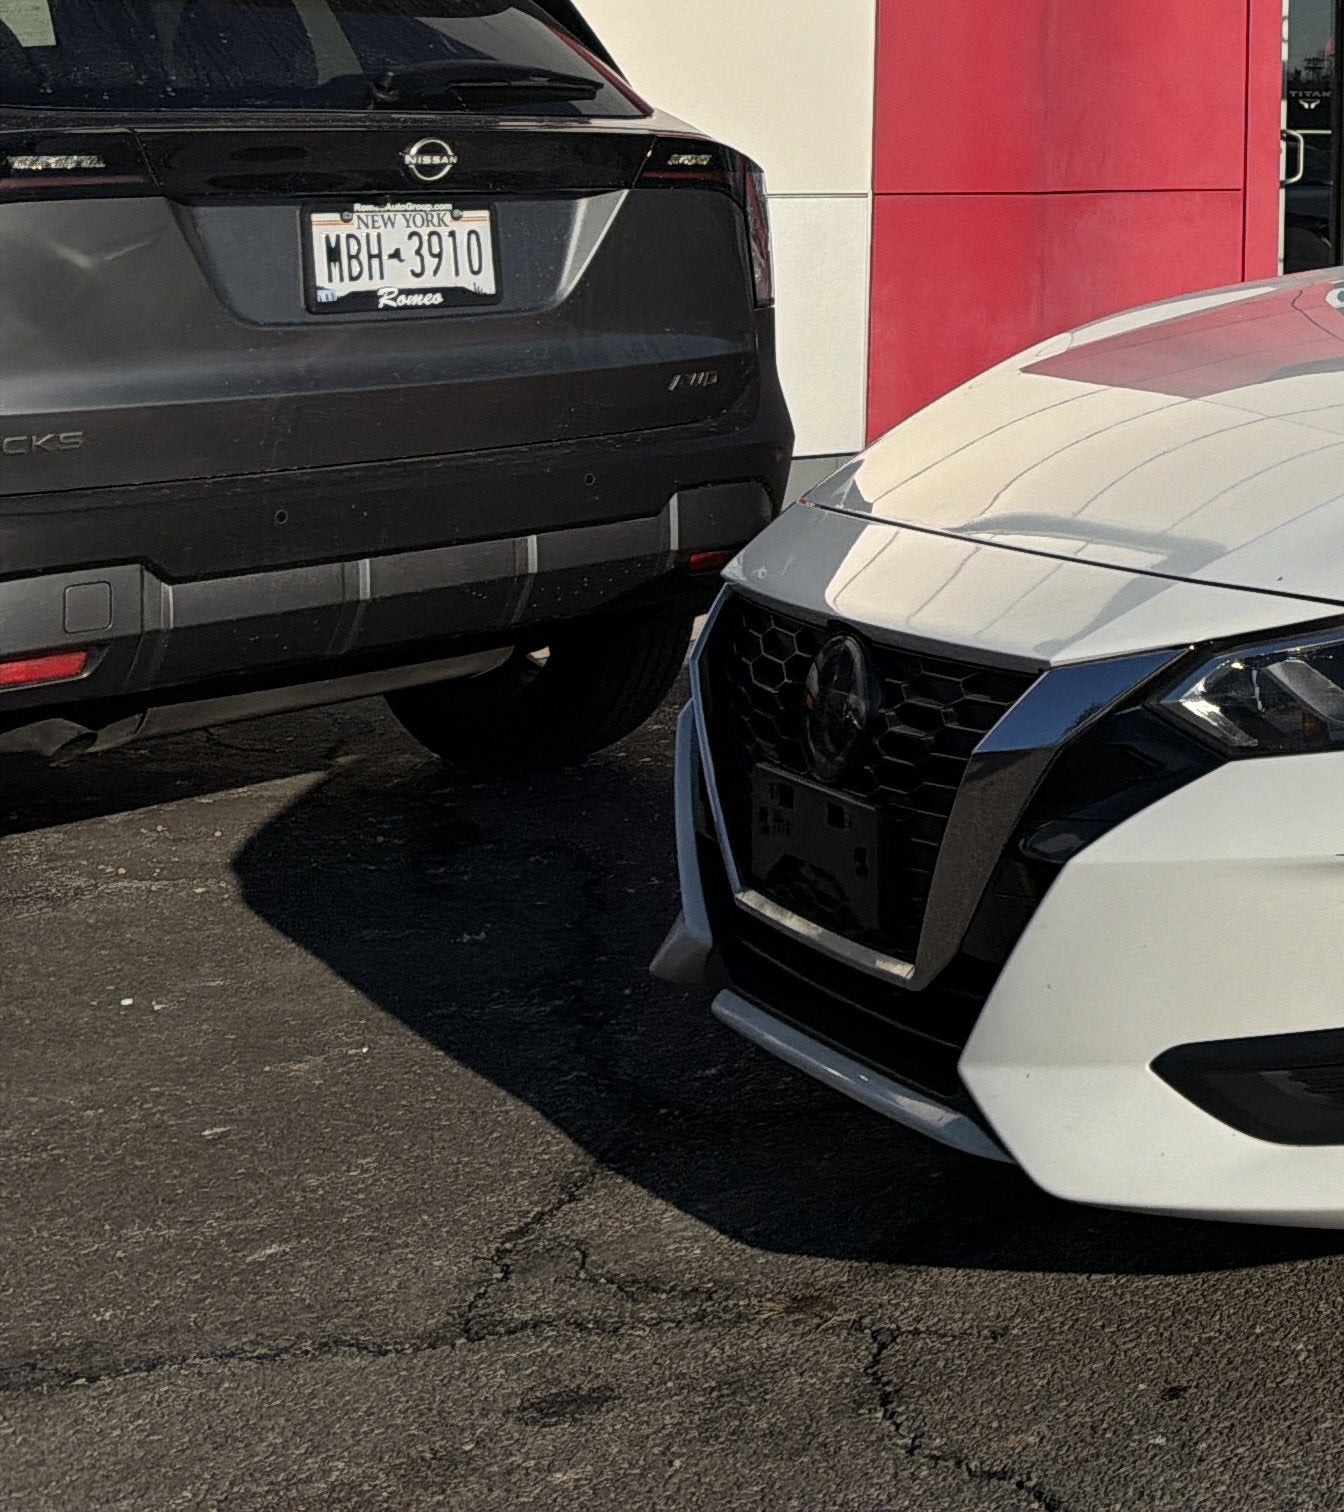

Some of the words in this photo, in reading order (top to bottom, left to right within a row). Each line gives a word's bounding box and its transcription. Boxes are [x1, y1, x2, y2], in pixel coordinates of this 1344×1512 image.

[404, 154, 458, 165] NISSAN
[356, 213, 397, 230] NEW
[402, 212, 450, 229] YORK
[325, 232, 385, 284] MBH
[407, 229, 483, 279] 3910
[377, 288, 444, 309] Romeo
